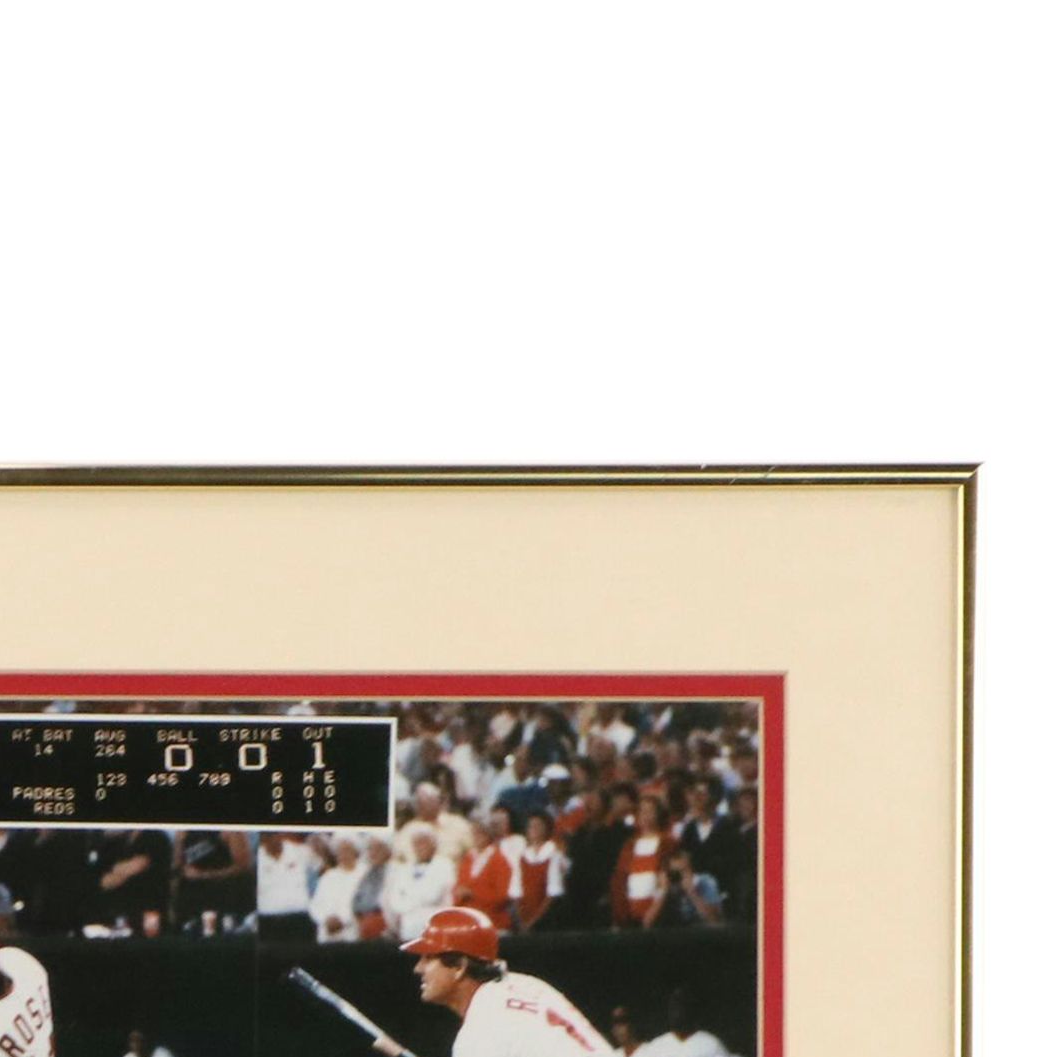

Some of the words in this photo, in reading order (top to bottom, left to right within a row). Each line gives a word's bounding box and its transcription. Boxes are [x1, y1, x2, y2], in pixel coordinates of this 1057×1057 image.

[12, 729, 33, 742] AT
[43, 729, 73, 742] BAT
[94, 729, 126, 742] AVG
[157, 729, 198, 742] BALL
[220, 728, 282, 742] STRIKE
[303, 727, 333, 740] OUT
[35, 743, 54, 757] 14
[164, 744, 193, 771] 0
[238, 743, 267, 771] 0
[312, 742, 326, 769] 1
[97, 773, 127, 786] 123
[147, 773, 179, 786] 456
[199, 773, 231, 786] 789
[271, 771, 283, 784] R
[303, 771, 315, 783] H
[323, 770, 336, 783] E
[12, 787, 75, 801] PADRES
[95, 788, 107, 801] 0
[272, 786, 284, 799] 0
[303, 785, 315, 798] 0
[324, 785, 336, 798] 0
[33, 802, 75, 815] REDS
[272, 801, 284, 814] 0
[305, 801, 313, 813] 1
